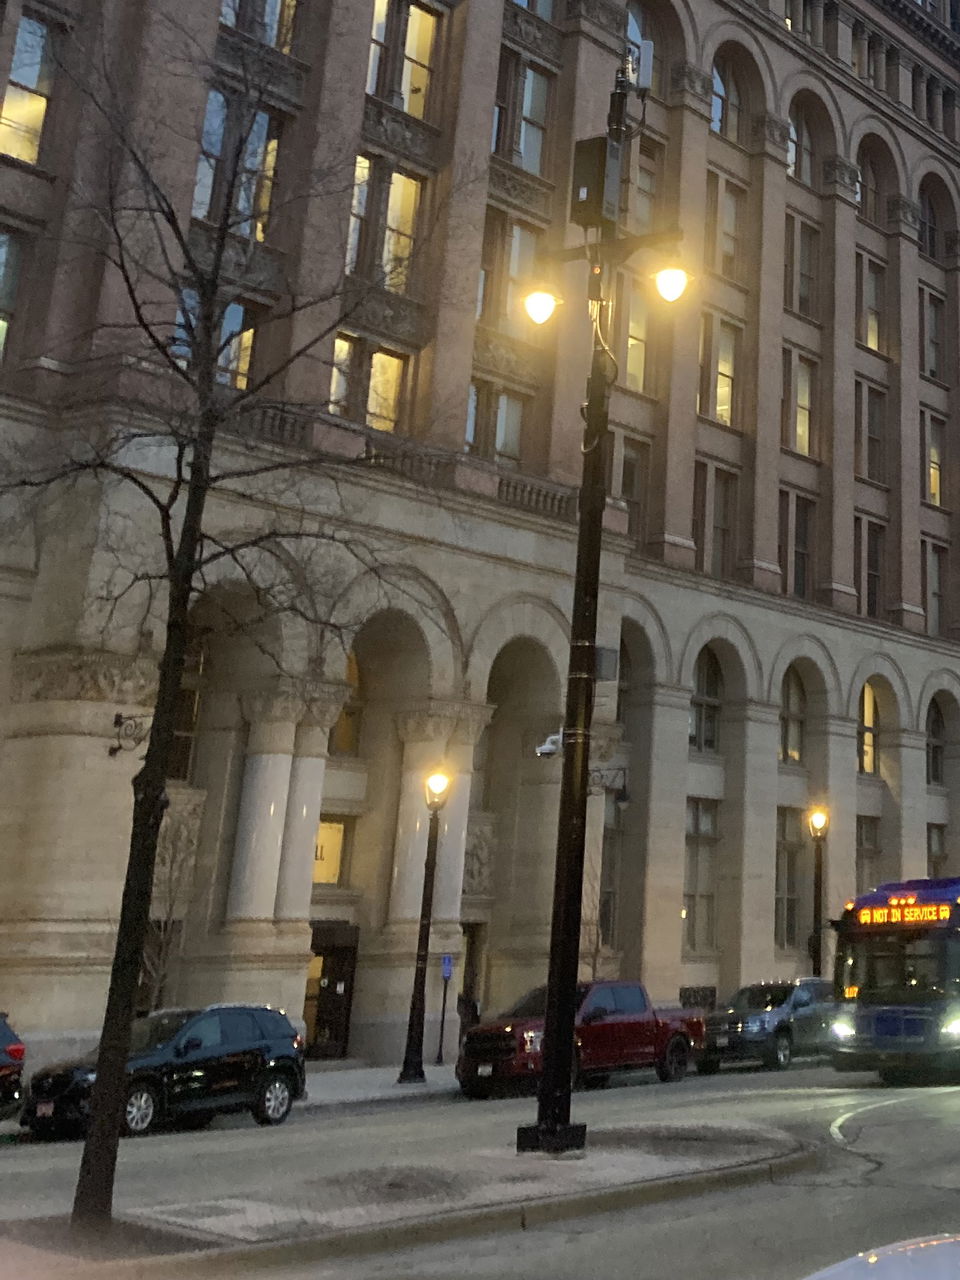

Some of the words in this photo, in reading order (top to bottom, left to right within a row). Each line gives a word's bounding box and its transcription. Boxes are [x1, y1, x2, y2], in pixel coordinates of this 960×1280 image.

[873, 908, 888, 922] NOT
[891, 908, 901, 922] IN
[904, 907, 937, 921] SERVICE
